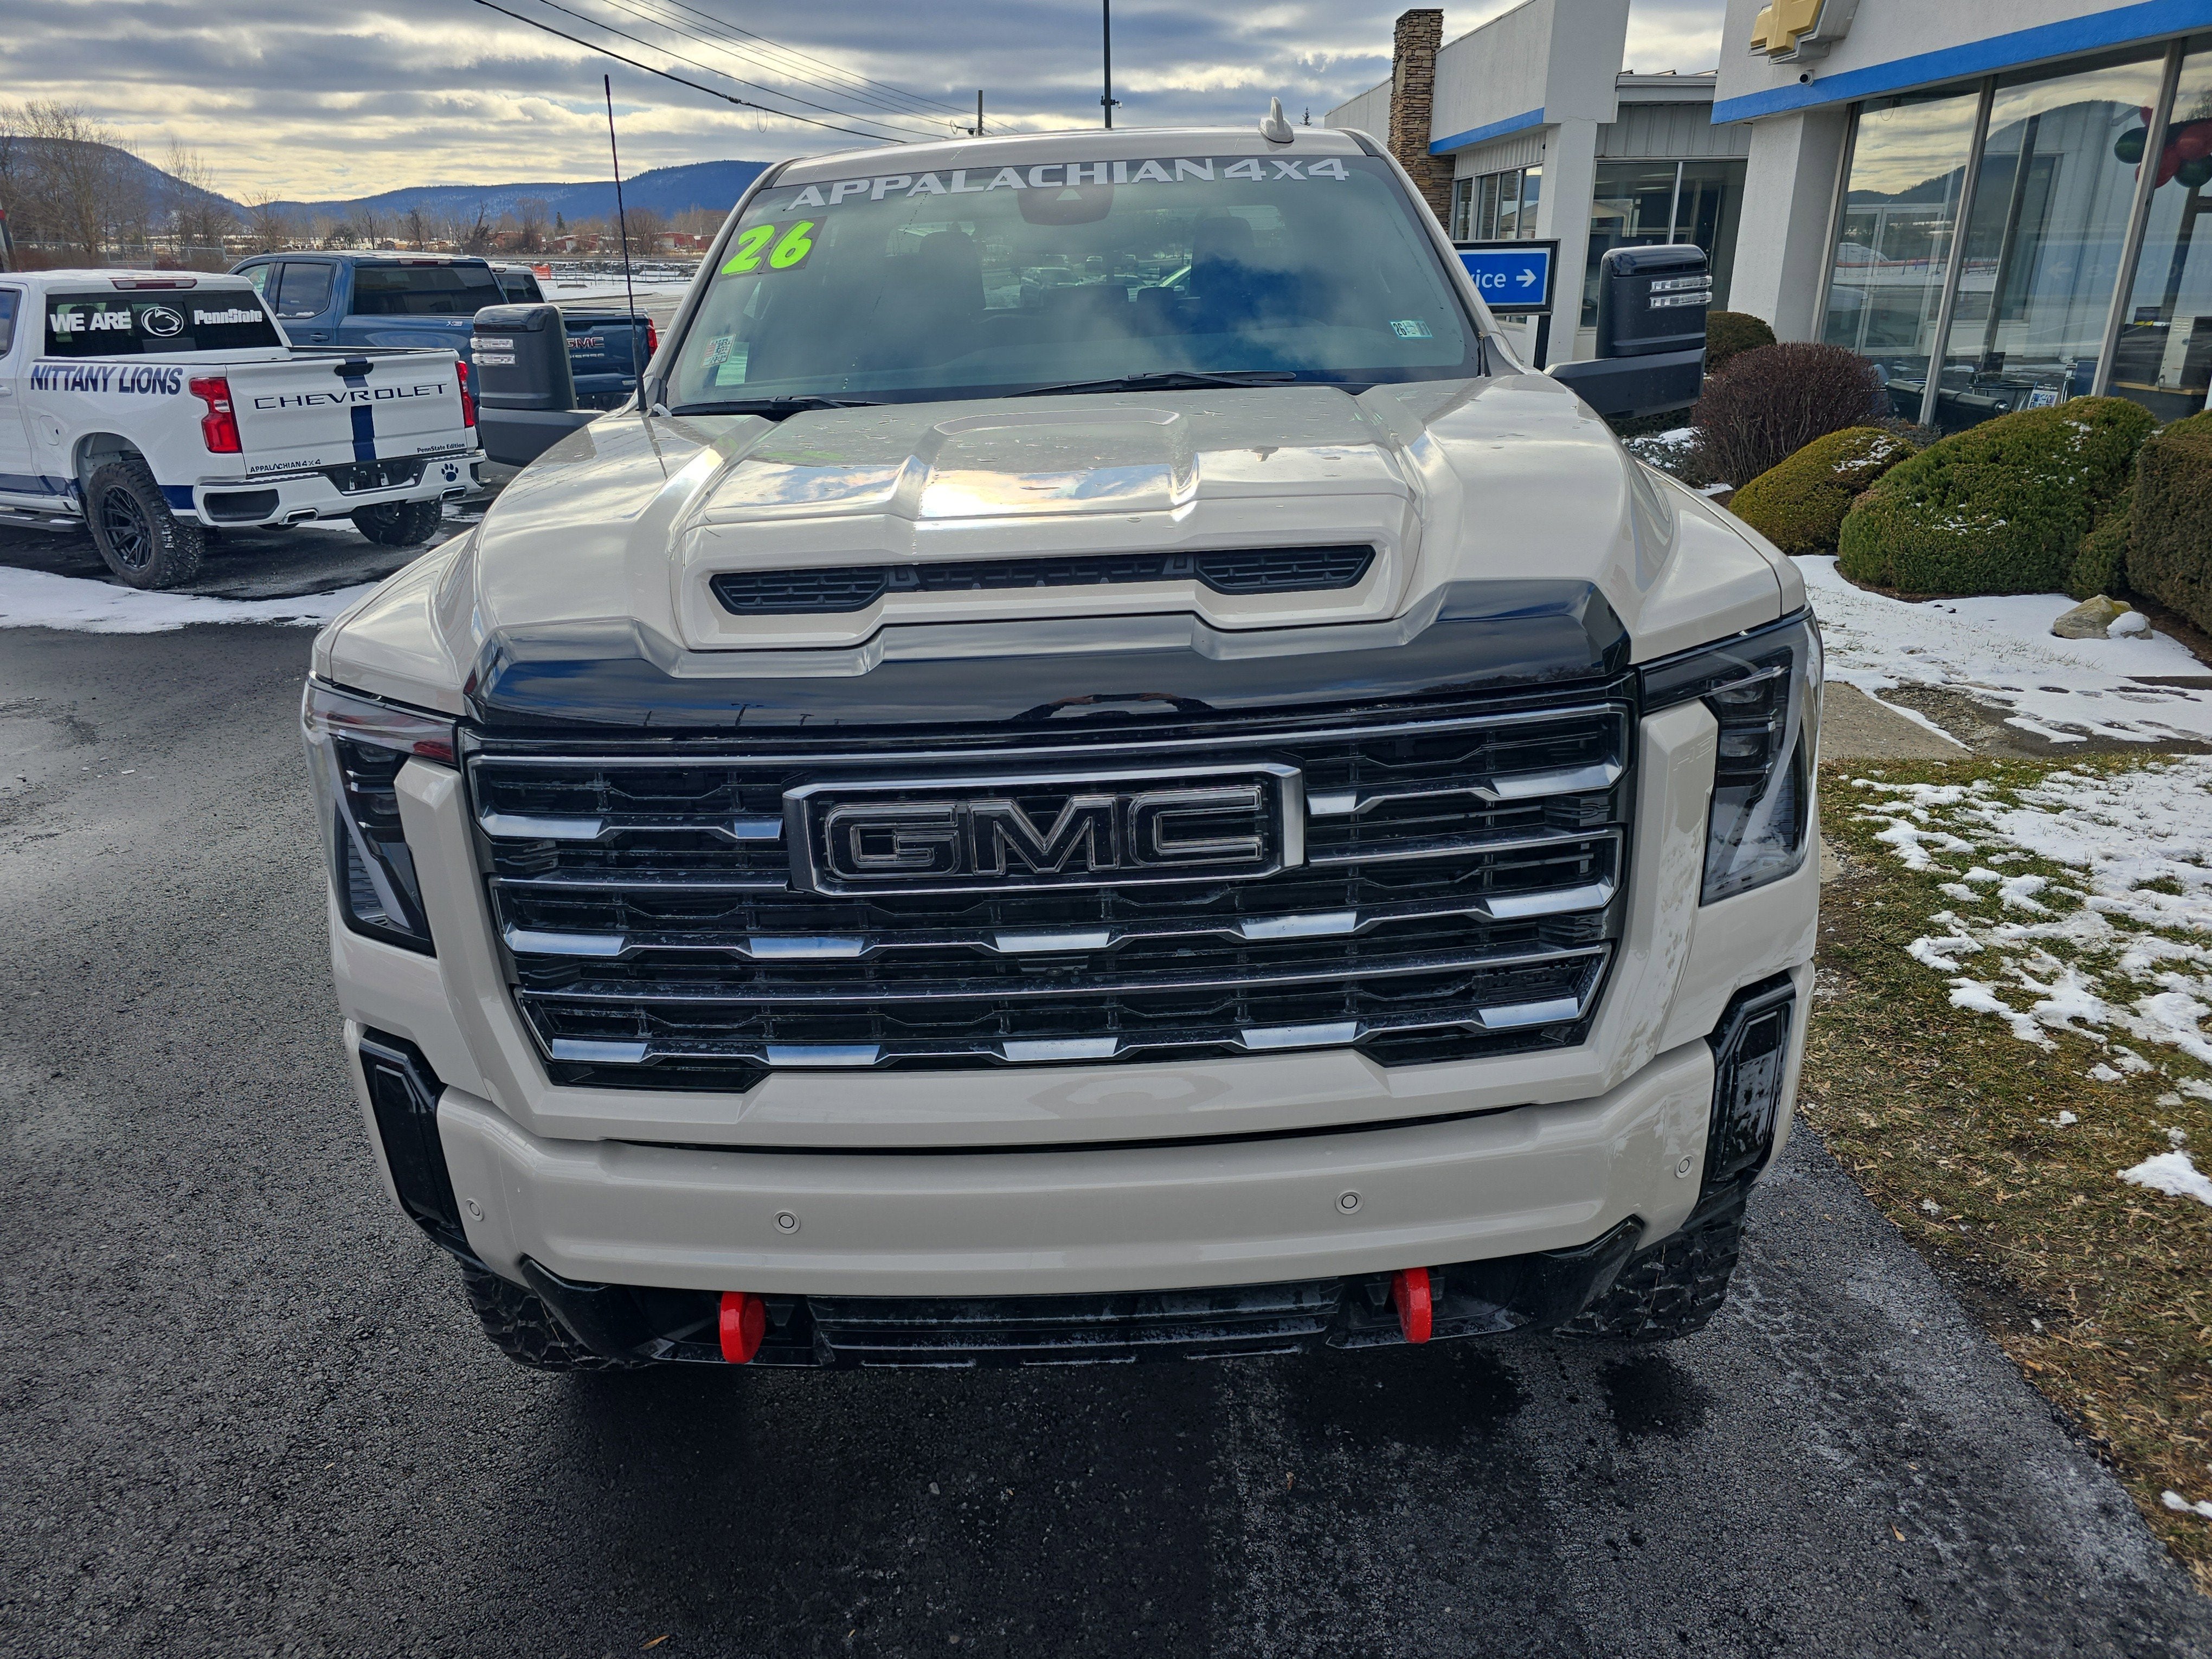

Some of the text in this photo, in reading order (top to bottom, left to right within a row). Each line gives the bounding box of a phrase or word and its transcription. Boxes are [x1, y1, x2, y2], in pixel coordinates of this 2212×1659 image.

[722, 221, 814, 276] 26
[50, 311, 132, 332] WE ARE
[1393, 323, 1407, 336] 26
[31, 365, 183, 395] NITTANY LIONS
[254, 383, 447, 409] CHEVROLET
[825, 784, 1263, 879] GMC
